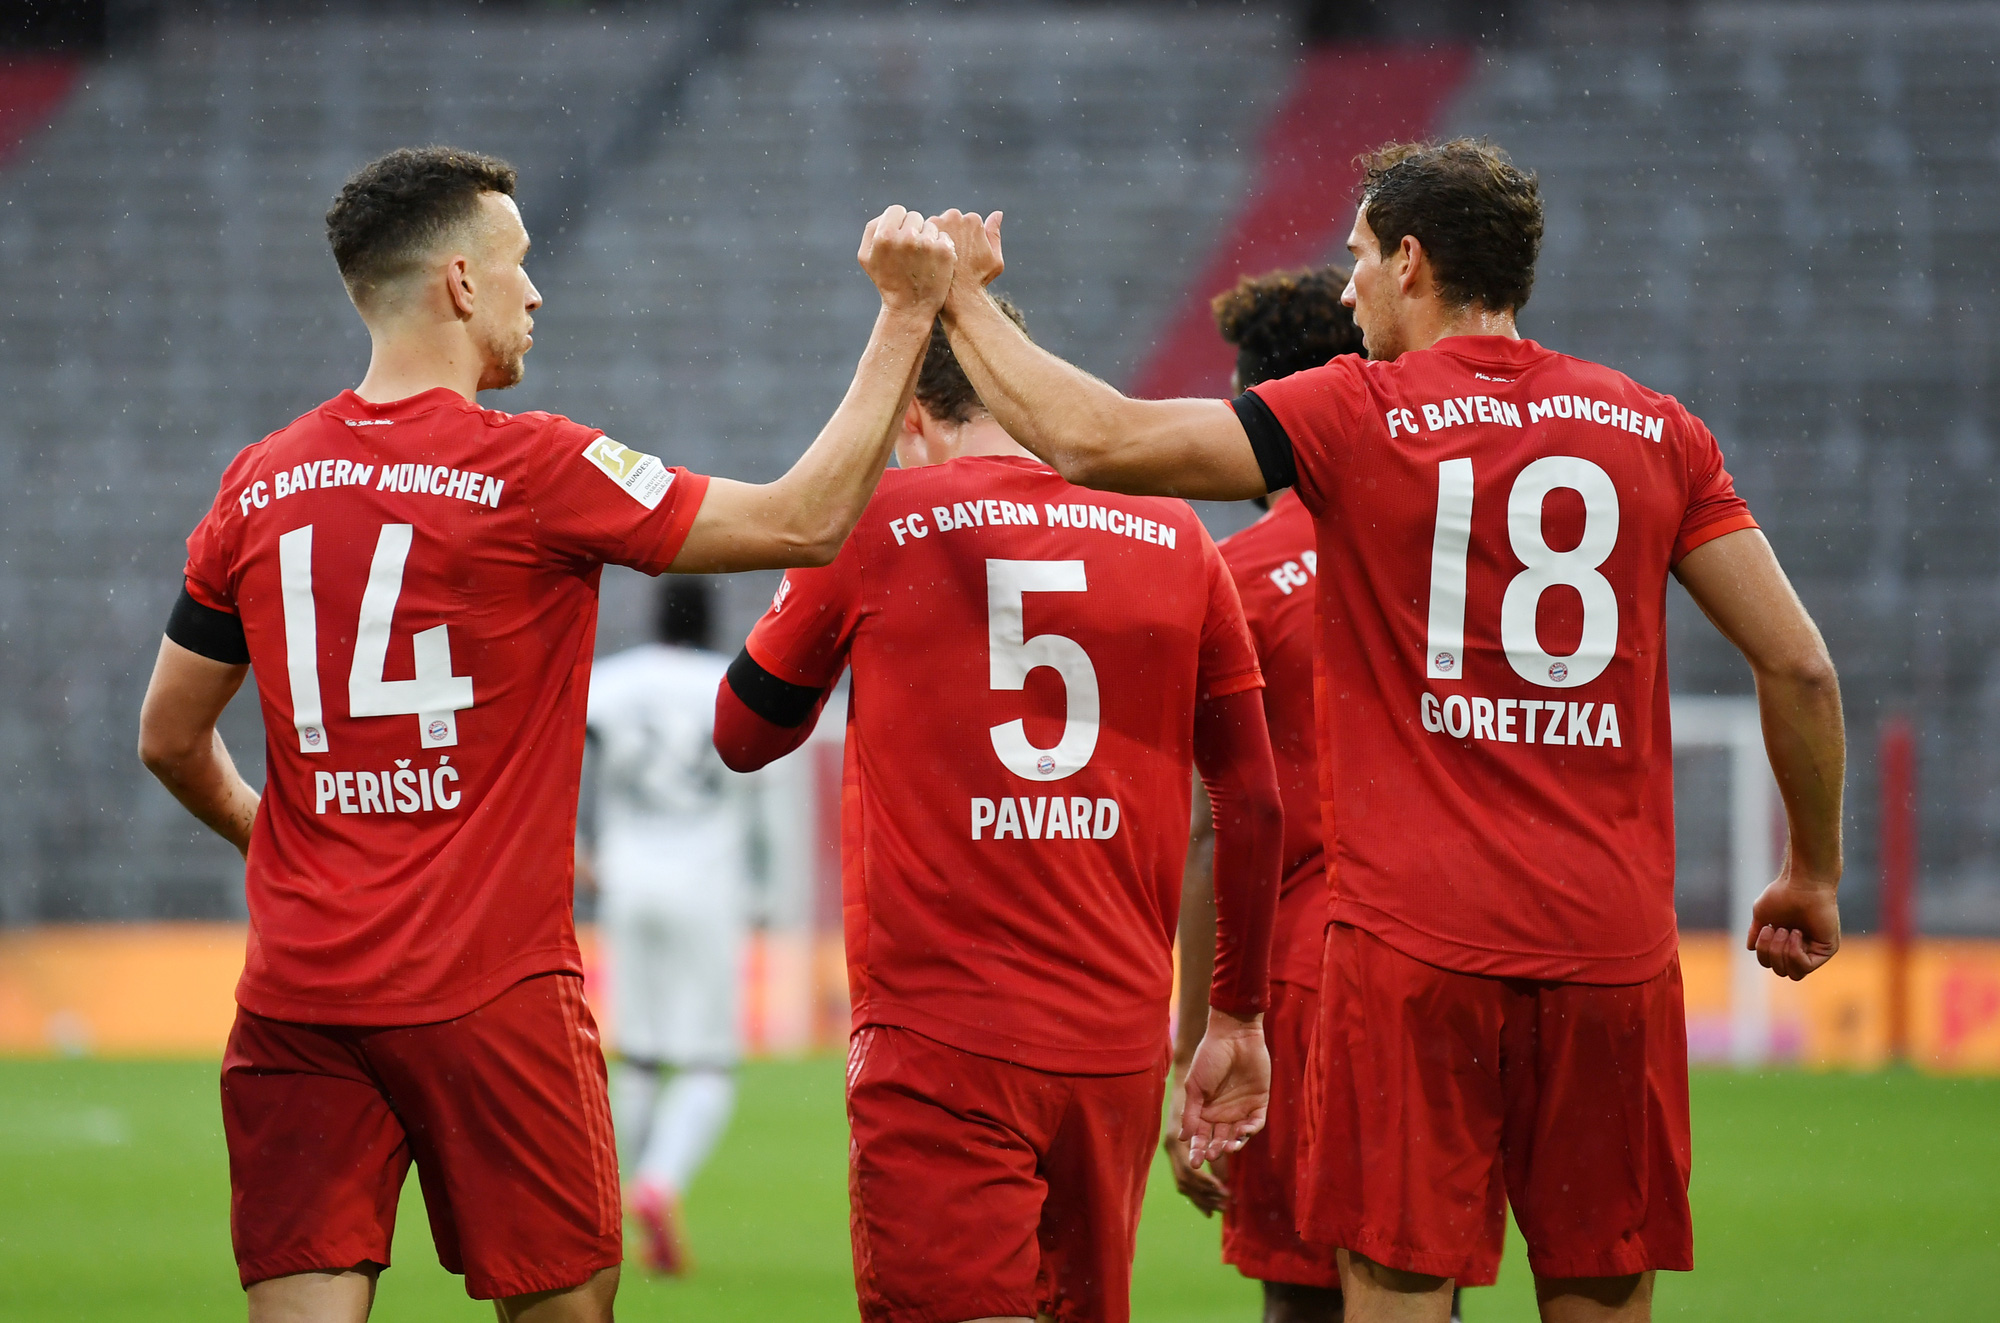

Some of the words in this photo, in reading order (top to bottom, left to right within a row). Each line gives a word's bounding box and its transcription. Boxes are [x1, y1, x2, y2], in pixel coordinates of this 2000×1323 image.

[1386, 407, 1420, 439] FC
[1422, 395, 1523, 432] BAYERN
[1527, 394, 1665, 443] MÜNCHEN
[238, 481, 270, 516] FC
[275, 459, 375, 500] BAYERN
[376, 463, 505, 509] MÜNCHEN
[888, 512, 929, 547] FC
[932, 499, 1040, 533] BAYERN
[1046, 503, 1177, 550] MÜNCHEN
[1269, 561, 1308, 595] FC
[1426, 455, 1620, 688] 18
[278, 523, 474, 754] 14
[985, 558, 1100, 782] 5
[1420, 692, 1622, 748] GORETZKA
[315, 755, 461, 815] PERIŠIĆ
[971, 796, 1120, 841] PAVARD
